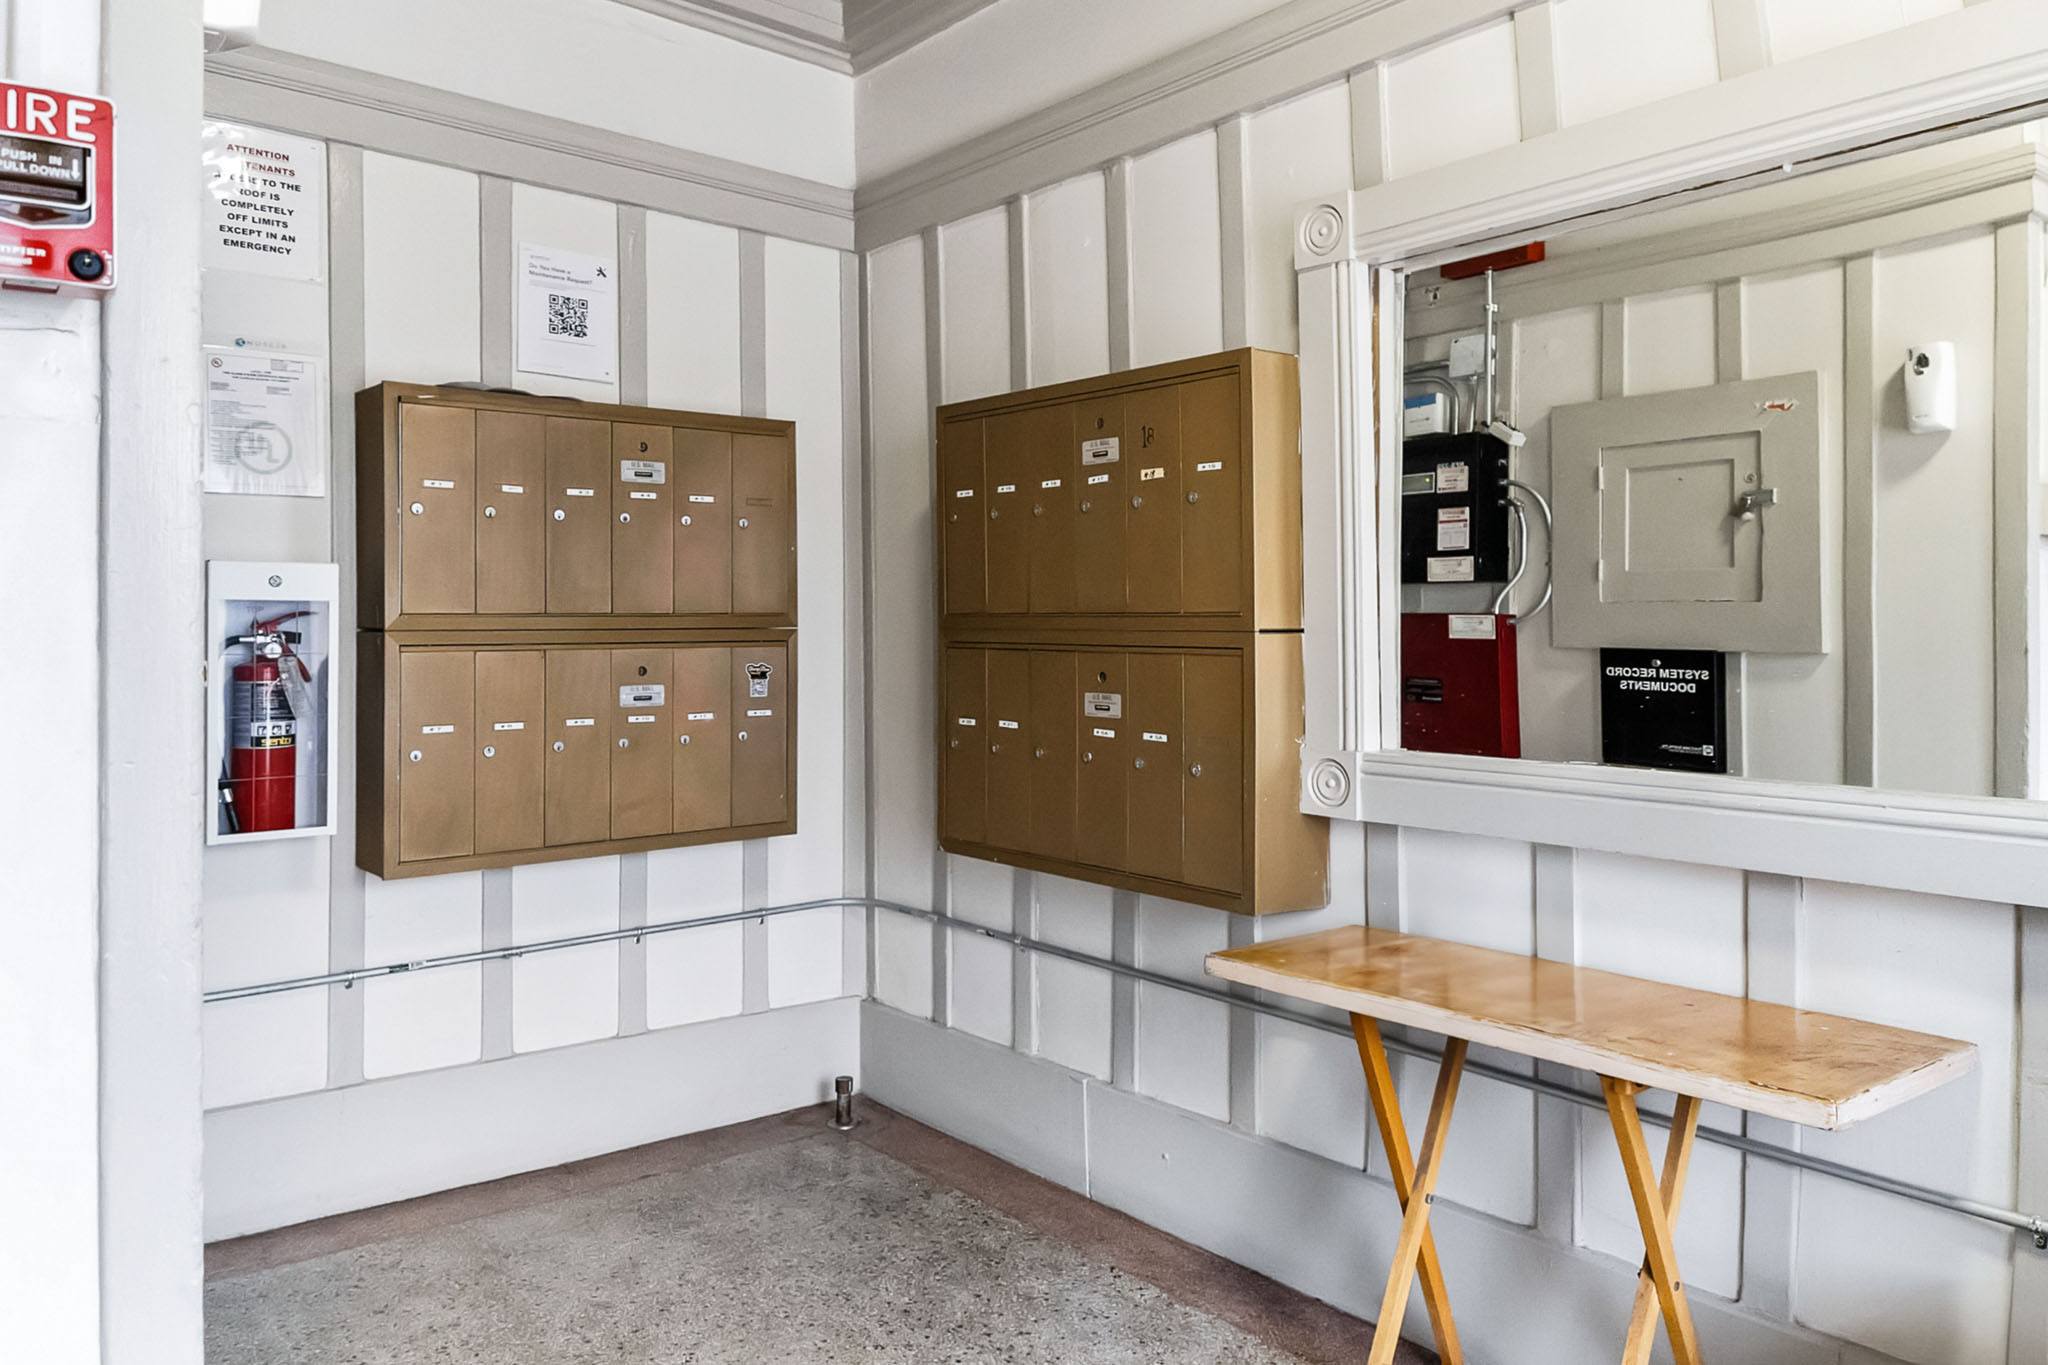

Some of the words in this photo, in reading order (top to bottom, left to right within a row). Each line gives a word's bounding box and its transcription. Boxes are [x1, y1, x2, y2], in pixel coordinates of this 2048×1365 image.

[1, 148, 37, 162] PUSH
[48, 155, 63, 166] IN
[226, 143, 290, 162] ATTENTION
[29, 163, 71, 178] DOWN
[245, 161, 296, 177] TENANTS
[262, 178, 277, 187] TO
[280, 181, 302, 192] THE
[270, 193, 280, 201] IS
[221, 198, 294, 216] COMPLETELY
[227, 212, 248, 222] OFF
[252, 216, 288, 228] LIMITS
[219, 224, 262, 238] EXCEPT
[266, 231, 277, 240] IN
[281, 234, 296, 243] AN
[223, 238, 292, 255] EMERGENCY
[1141, 424, 1155, 449] 18
